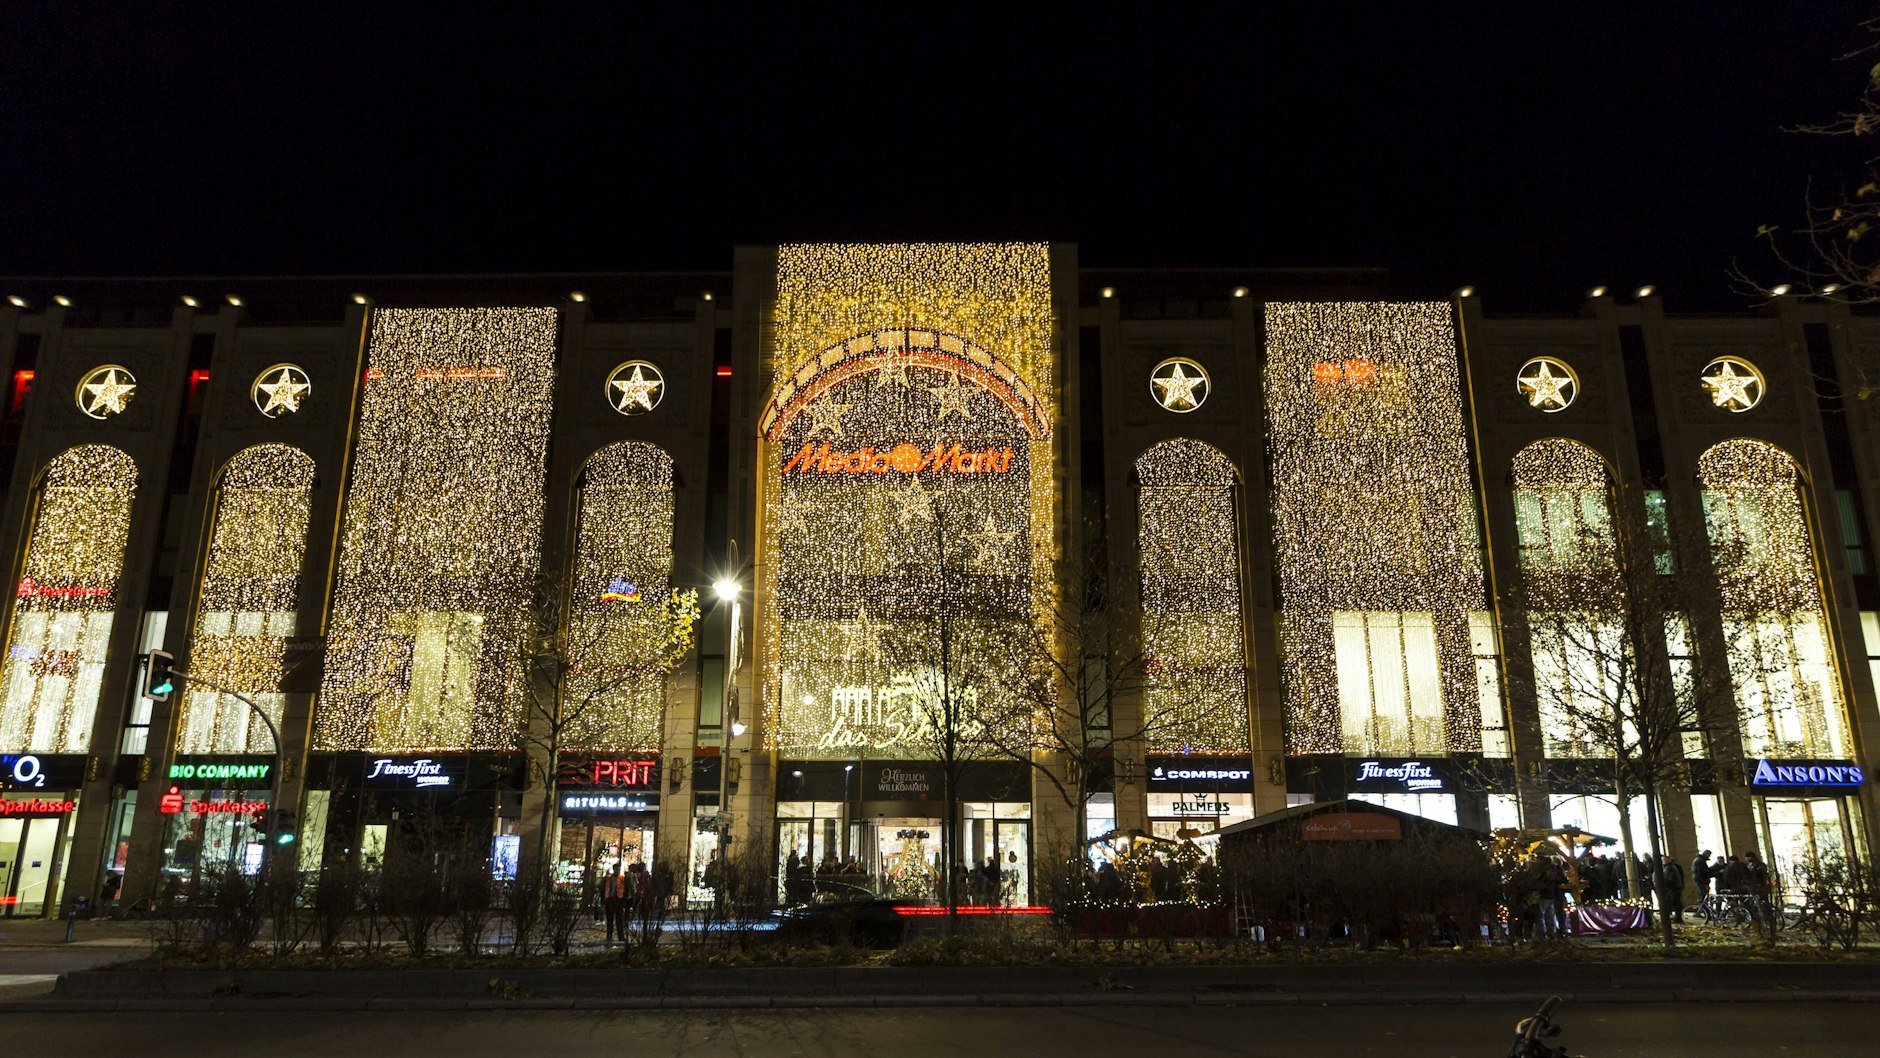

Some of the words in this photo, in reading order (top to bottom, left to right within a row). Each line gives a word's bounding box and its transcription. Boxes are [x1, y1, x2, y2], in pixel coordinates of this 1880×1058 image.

[169, 764, 195, 779] BIO
[196, 764, 270, 779] COMPANY
[1167, 770, 1250, 780] COMSPOT
[878, 783, 930, 792] WILLKOMMEN
[0, 797, 74, 816] Sparkasse
[189, 798, 268, 816] Sparkasse
[1172, 801, 1230, 812] PALMERS
